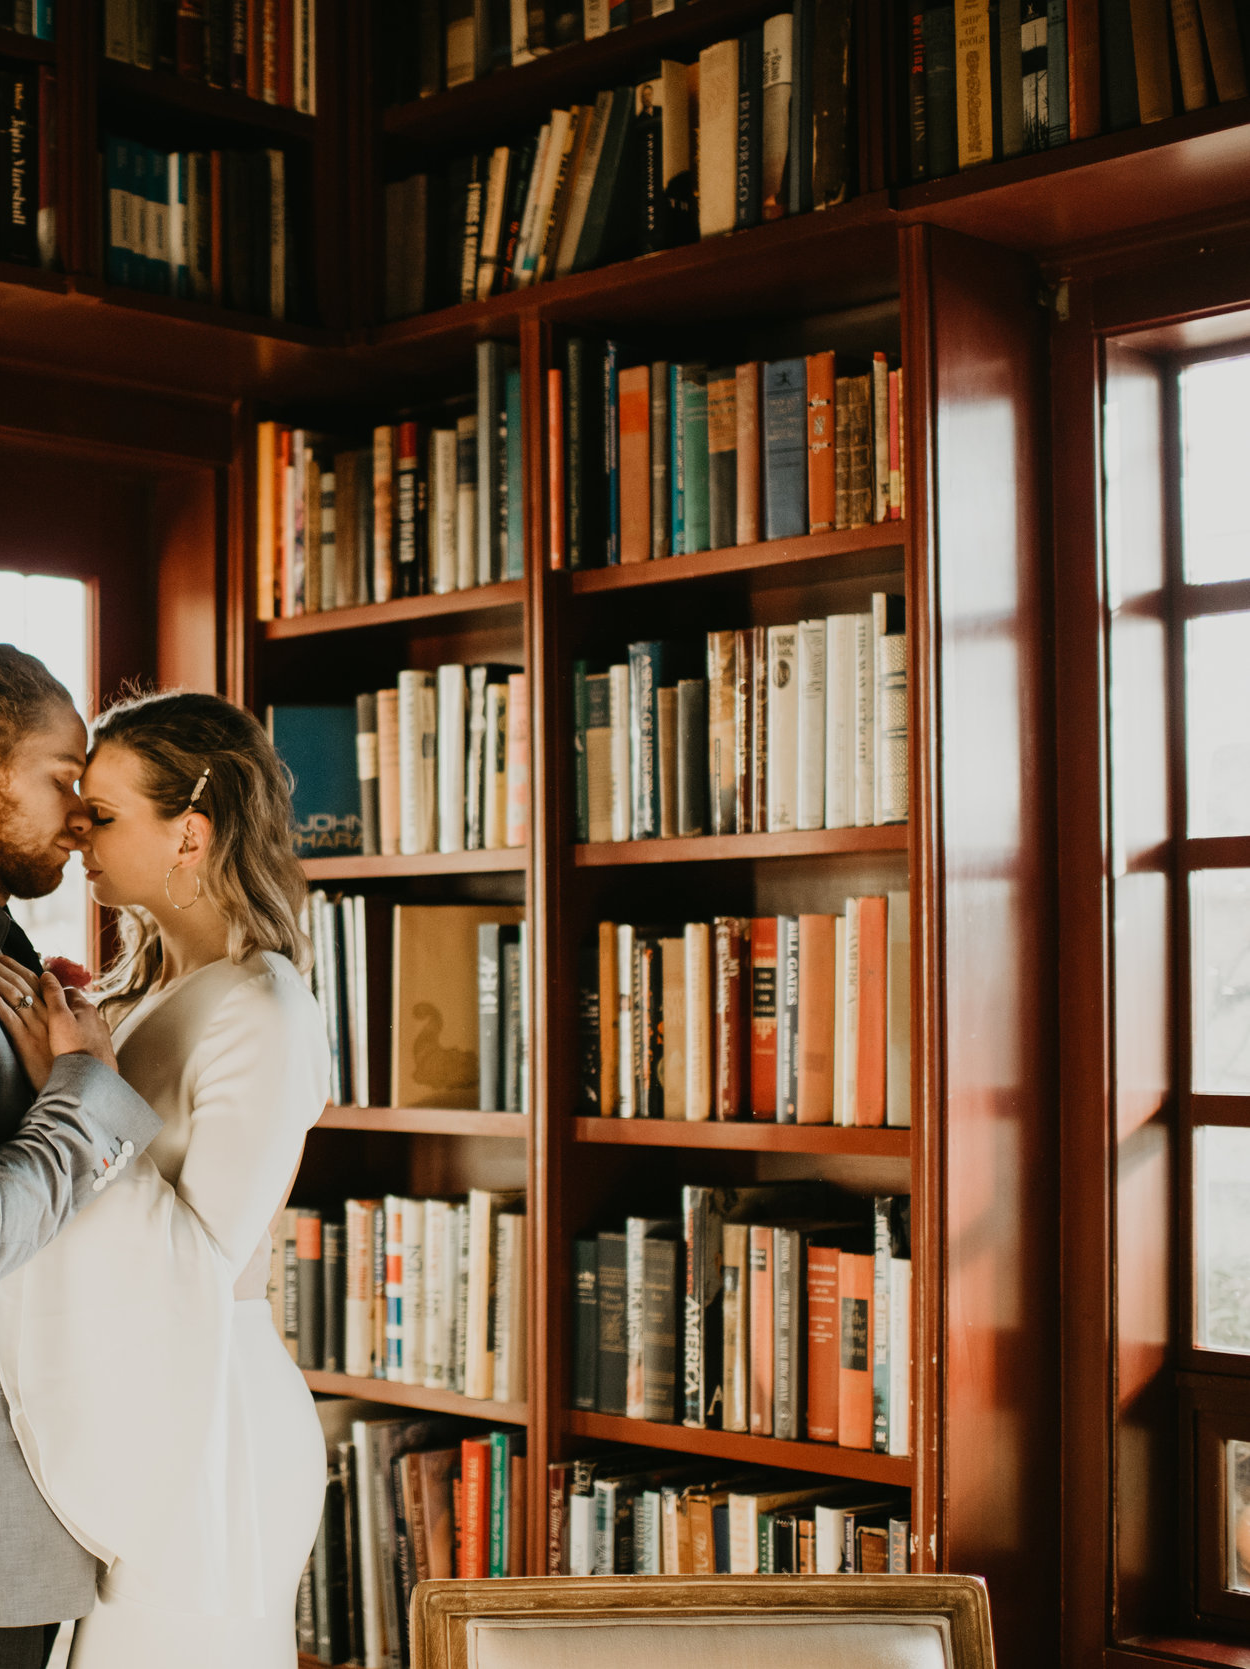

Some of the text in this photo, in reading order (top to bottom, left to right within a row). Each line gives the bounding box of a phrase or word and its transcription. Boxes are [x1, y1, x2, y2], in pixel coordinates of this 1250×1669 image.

[10, 159, 28, 226] Marshall
[786, 921, 799, 955] BILL
[786, 957, 799, 1006] GATES
[685, 1295, 700, 1395] AMERICA
[550, 1488, 563, 1507] The
[549, 1551, 562, 1568] The
